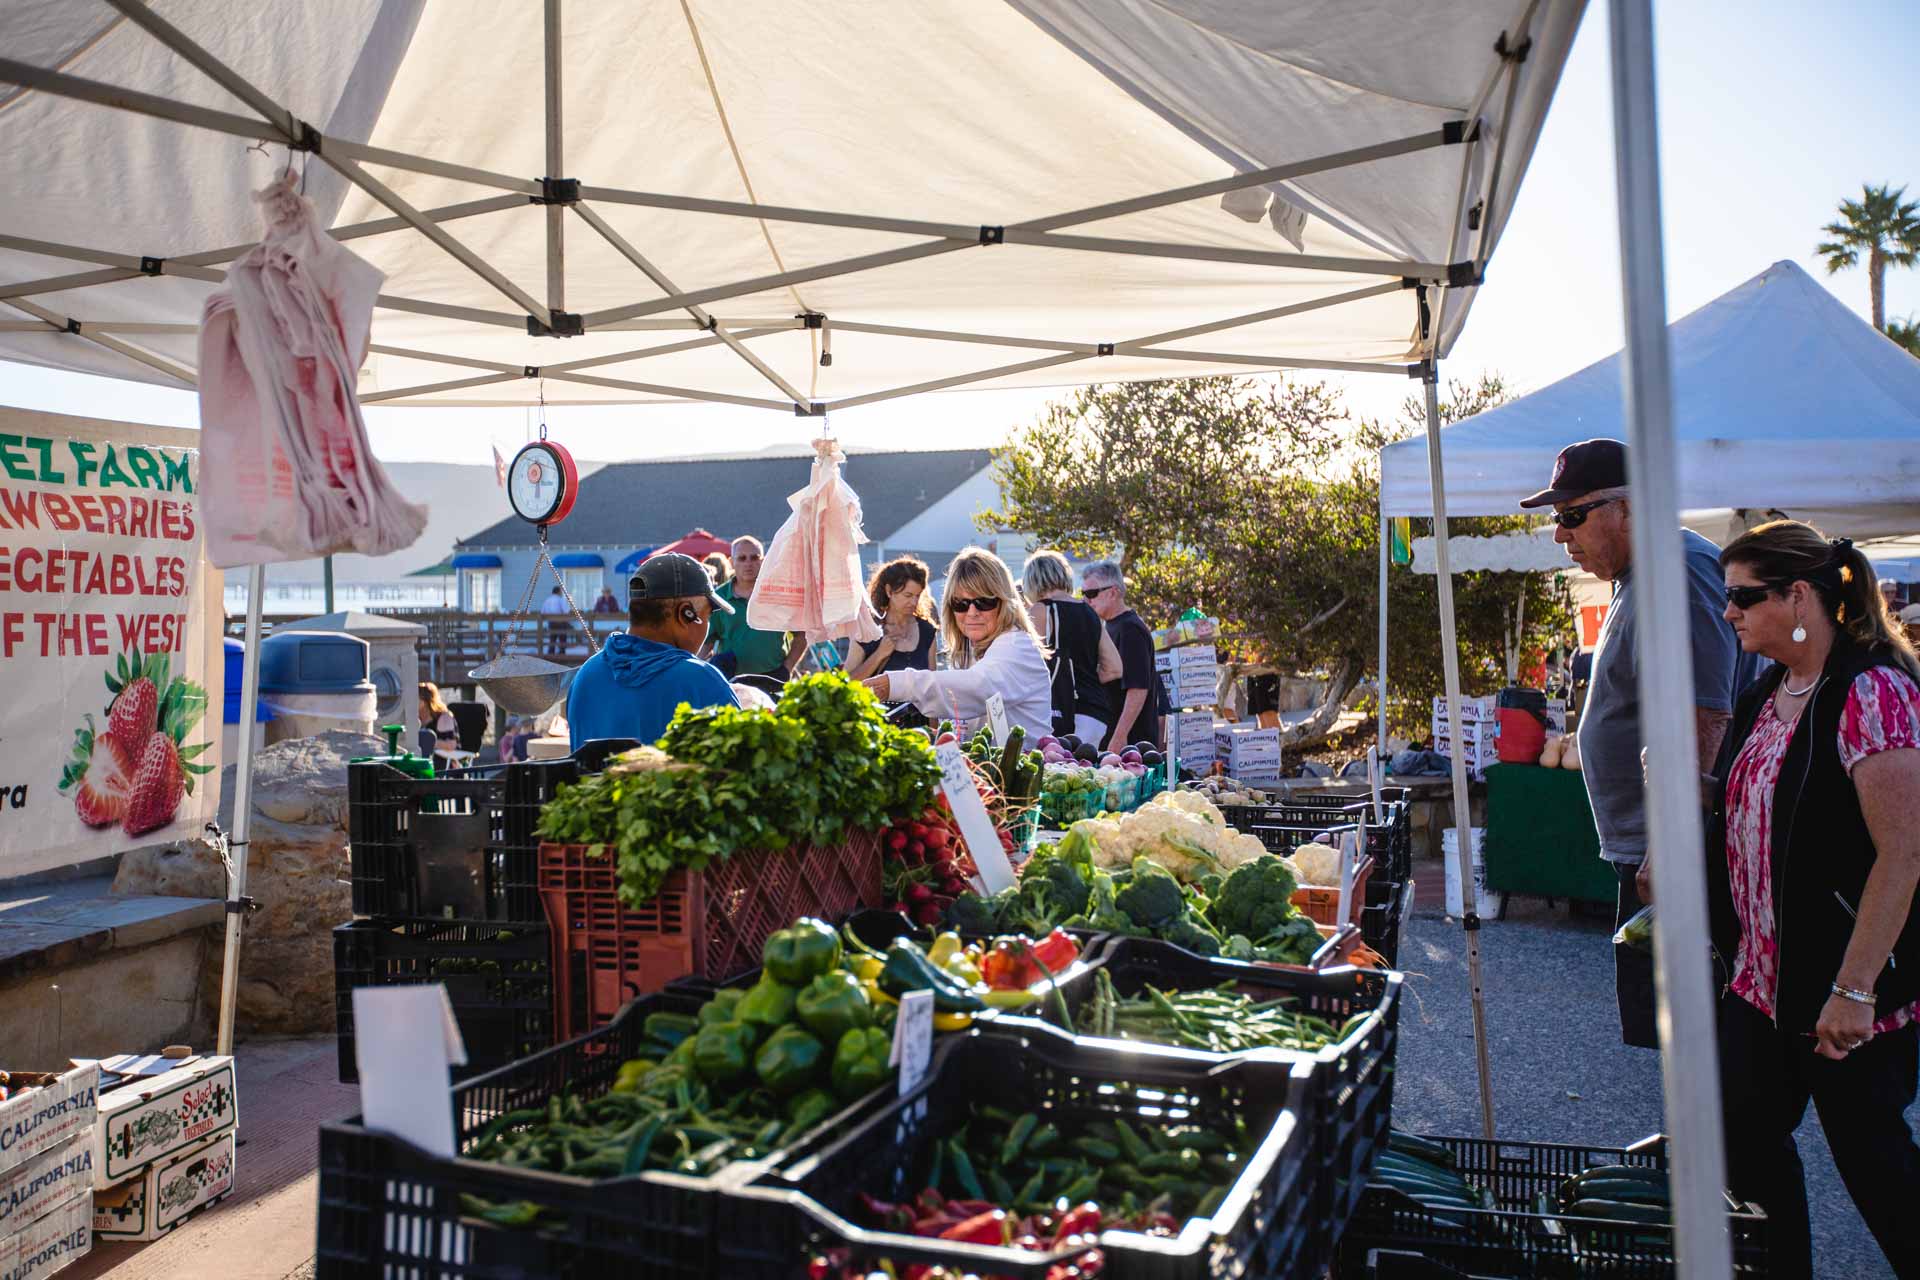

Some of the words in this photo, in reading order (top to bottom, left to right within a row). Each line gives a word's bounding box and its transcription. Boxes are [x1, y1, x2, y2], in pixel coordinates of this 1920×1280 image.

[68, 441, 193, 494] FARM
[34, 614, 109, 657] THE
[115, 614, 187, 653] WEST
[0, 1086, 97, 1151] CALIFORNIA
[181, 1079, 212, 1120] Select
